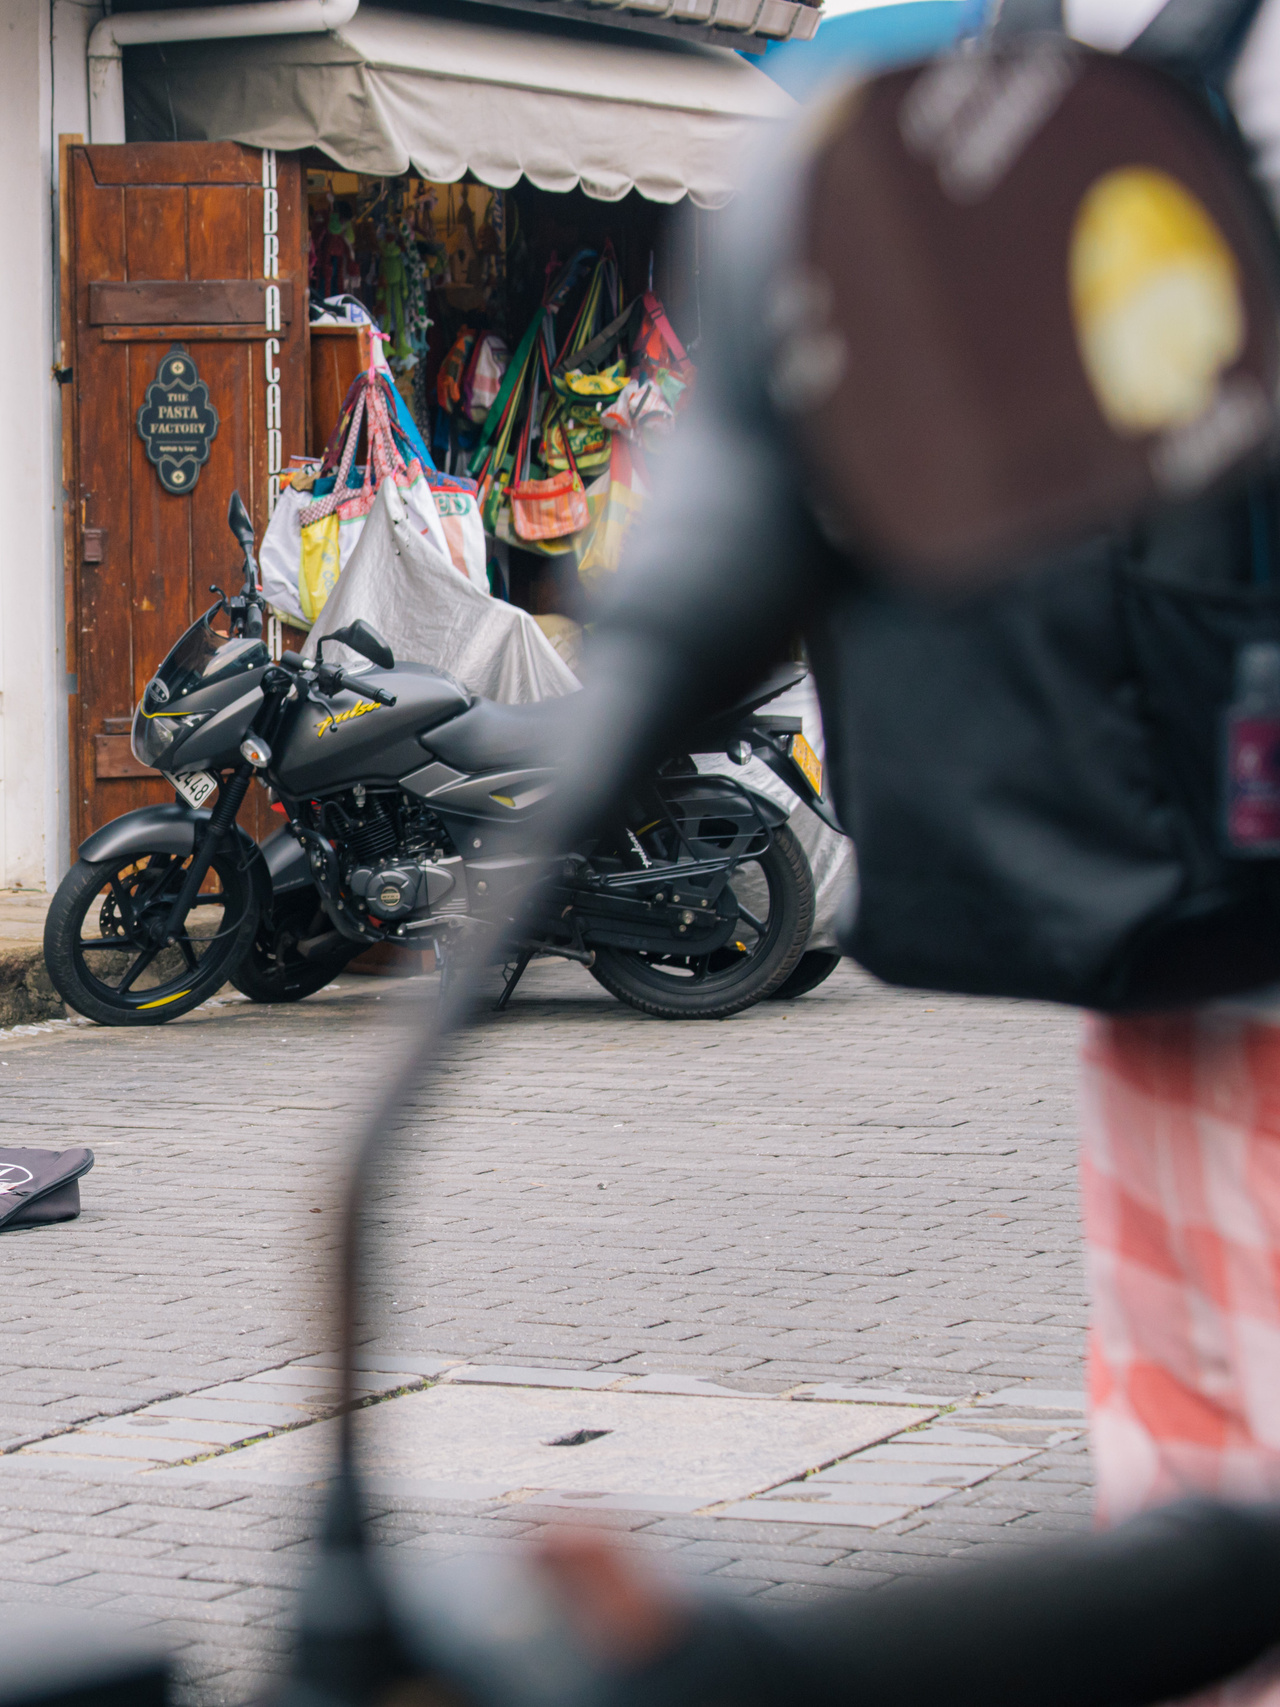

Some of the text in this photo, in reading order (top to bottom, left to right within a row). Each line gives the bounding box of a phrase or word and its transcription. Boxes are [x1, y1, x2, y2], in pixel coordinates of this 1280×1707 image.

[167, 393, 189, 402] THE
[158, 406, 199, 419] PASTA
[150, 423, 206, 434] FACTORY
